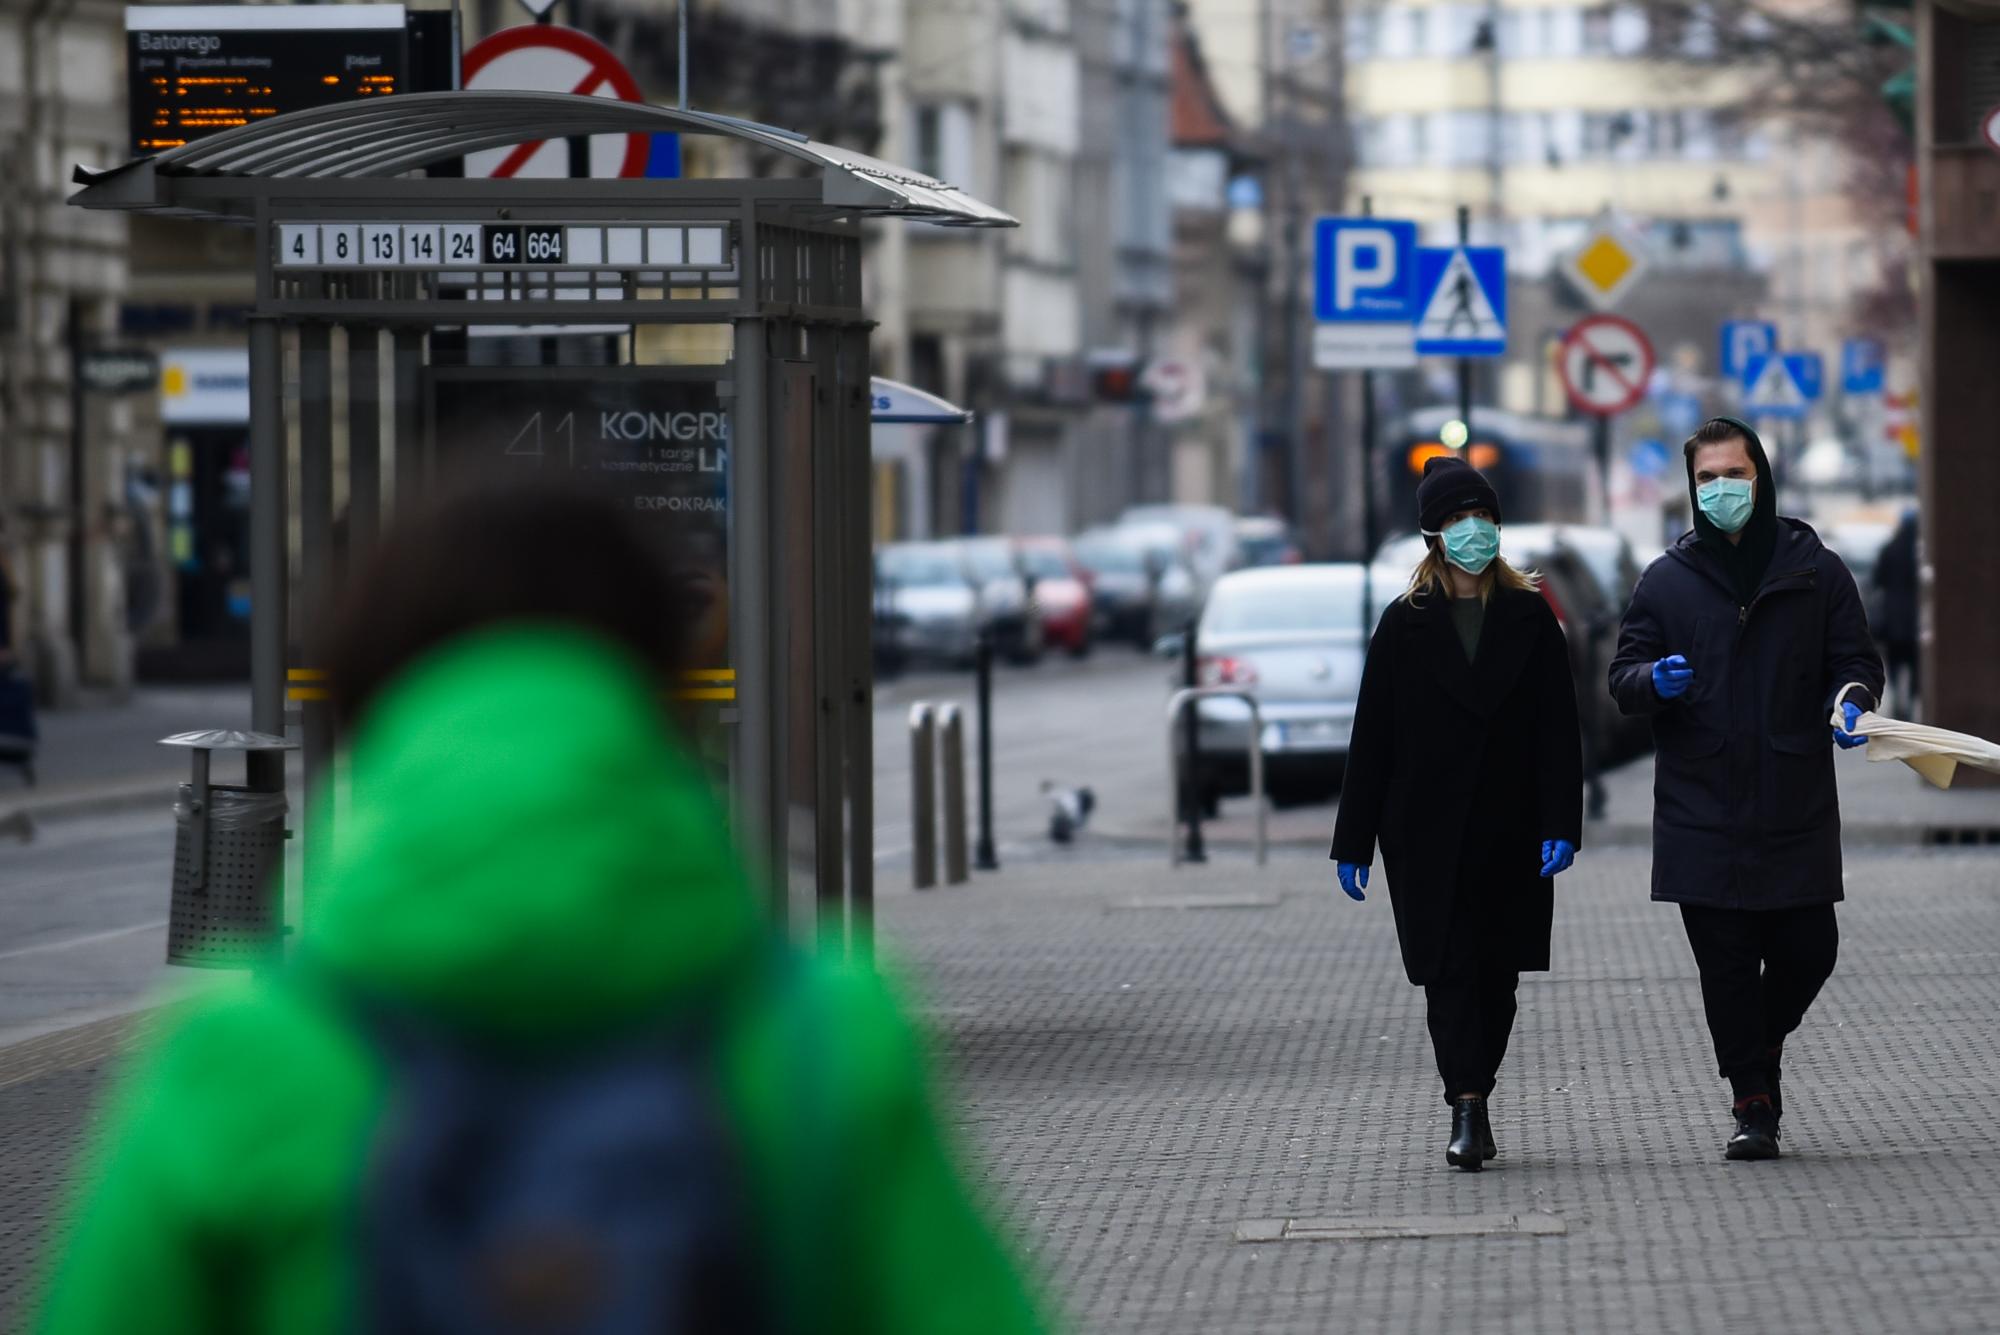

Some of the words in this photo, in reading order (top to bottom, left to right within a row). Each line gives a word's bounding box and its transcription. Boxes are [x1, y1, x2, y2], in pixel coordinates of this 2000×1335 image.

[139, 32, 221, 54] Batorego
[293, 233, 304, 258] 4
[336, 232, 348, 259] 8
[372, 233, 393, 259] 13
[411, 233, 432, 258] 14
[452, 233, 474, 259] 24
[492, 232, 515, 259] 64
[527, 232, 561, 259] 664
[1335, 228, 1397, 311] P
[661, 446, 694, 462] targi
[600, 459, 694, 474] kosmetyczne
[634, 496, 726, 512] EXPOKRAK
